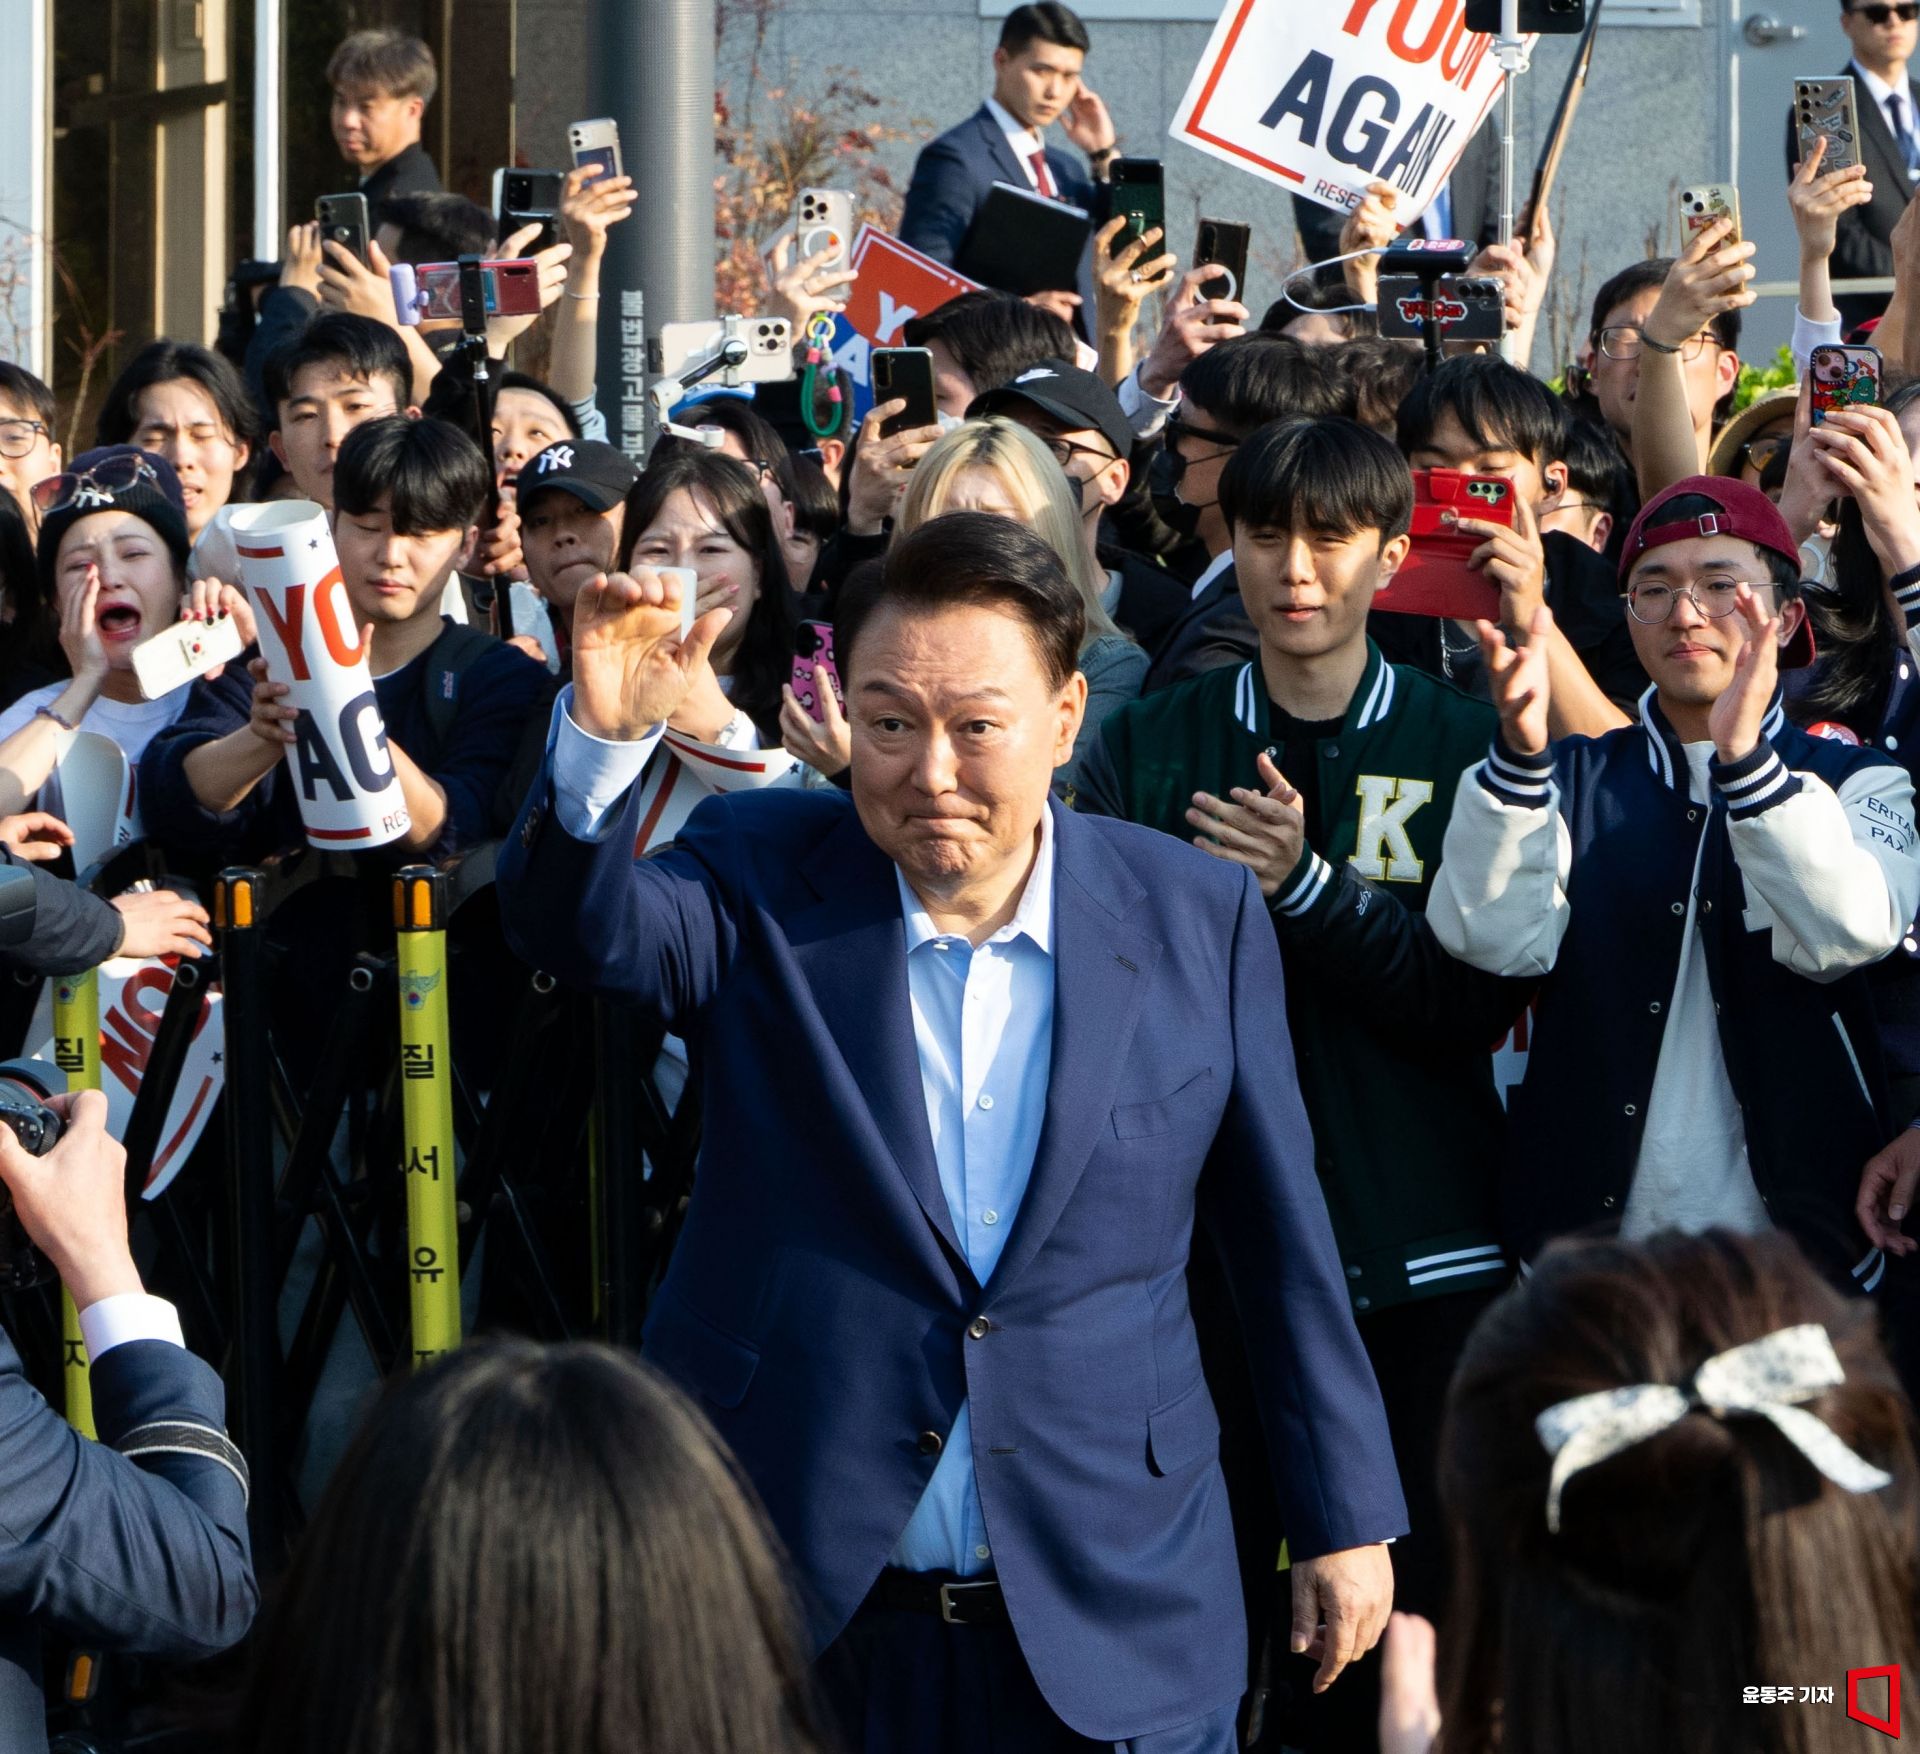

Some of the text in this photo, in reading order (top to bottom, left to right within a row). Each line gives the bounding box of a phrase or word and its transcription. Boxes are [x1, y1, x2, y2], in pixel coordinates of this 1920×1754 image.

[1258, 49, 1456, 198] AGAIN
[1313, 178, 1365, 210] RESE
[874, 290, 918, 344] Y
[538, 445, 575, 475] NY
[1346, 774, 1434, 884] K
[1854, 797, 1915, 846] ERITA
[1871, 826, 1904, 854] PAX
